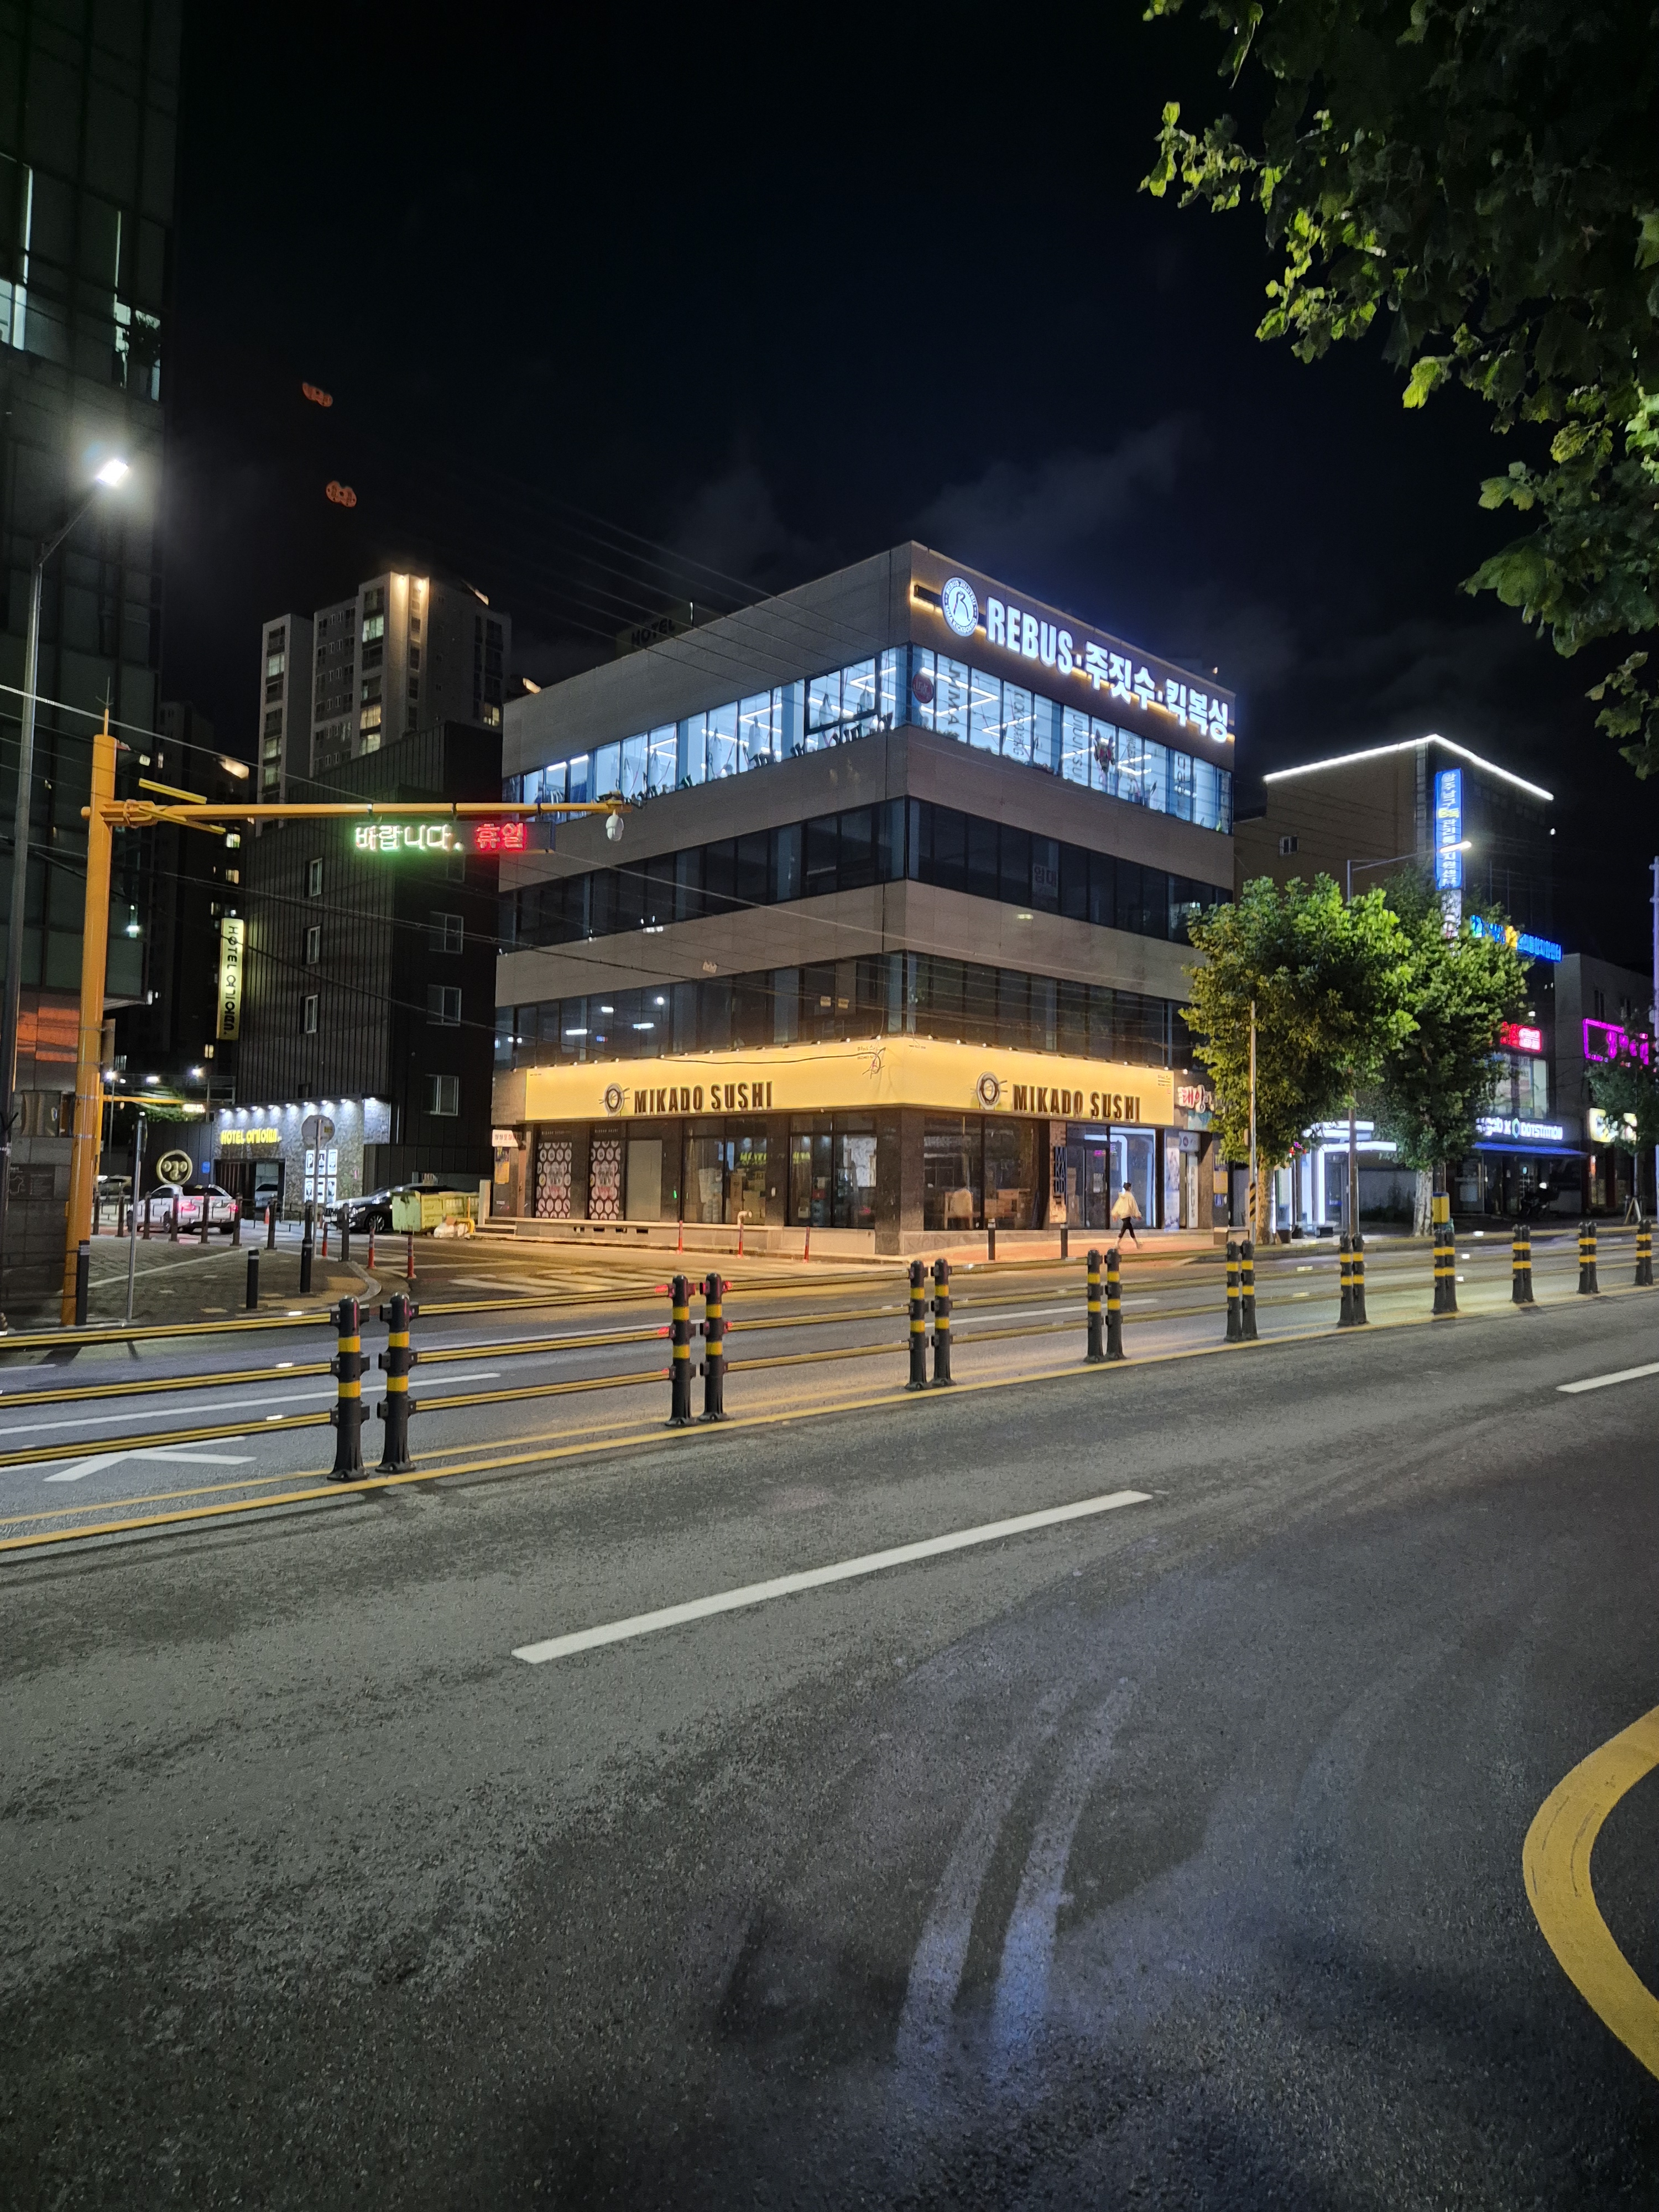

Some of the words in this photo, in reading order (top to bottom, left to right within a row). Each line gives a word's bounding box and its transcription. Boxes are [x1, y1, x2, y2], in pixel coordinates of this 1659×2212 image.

[987, 596, 1073, 676] REBUS
[476, 823, 524, 849] 휴일
[227, 926, 238, 969] HOTEL
[634, 1085, 703, 1114] MIKADO
[711, 1081, 773, 1109] SUSHI
[1013, 1084, 1083, 1117] MIKADO
[1090, 1091, 1140, 1122] SUSHI
[221, 1130, 244, 1145] HOTEL
